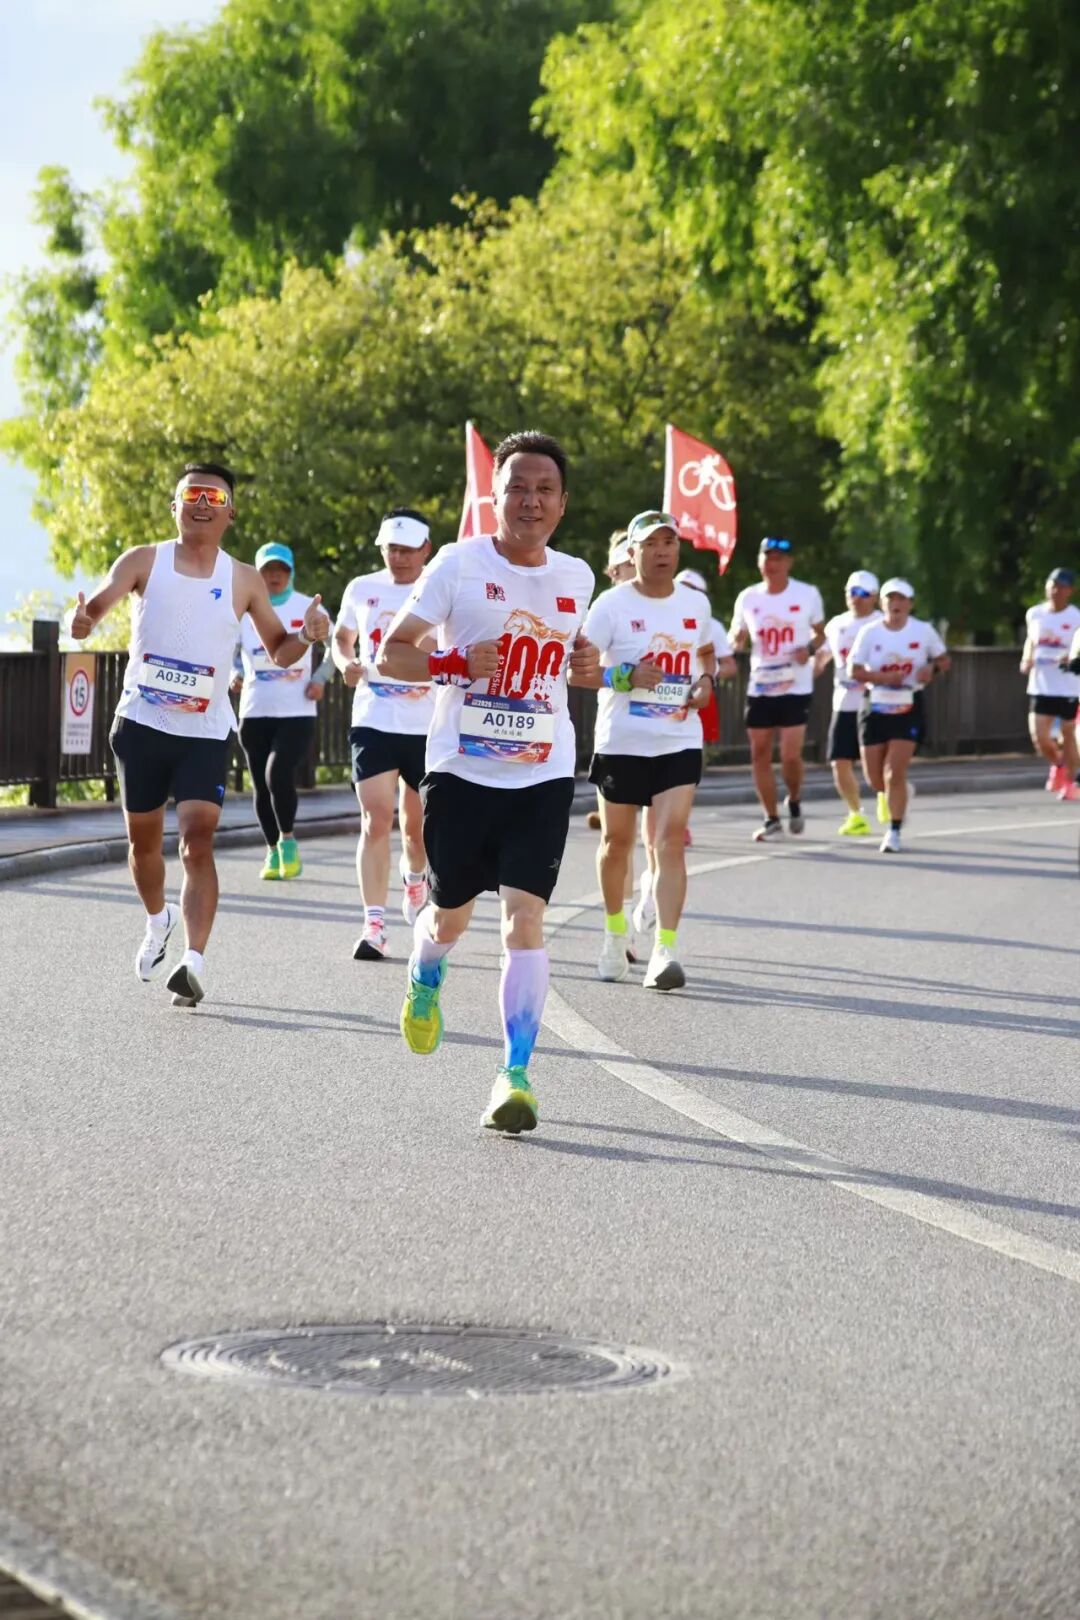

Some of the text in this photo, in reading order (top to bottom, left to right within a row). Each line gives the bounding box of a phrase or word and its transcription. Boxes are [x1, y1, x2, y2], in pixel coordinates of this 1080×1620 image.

[487, 633, 565, 698] 100
[640, 650, 691, 676] 00
[156, 669, 197, 687] A0323
[490, 654, 505, 696] 42195km
[75, 687, 85, 707] 15
[482, 712, 535, 729] A0189
